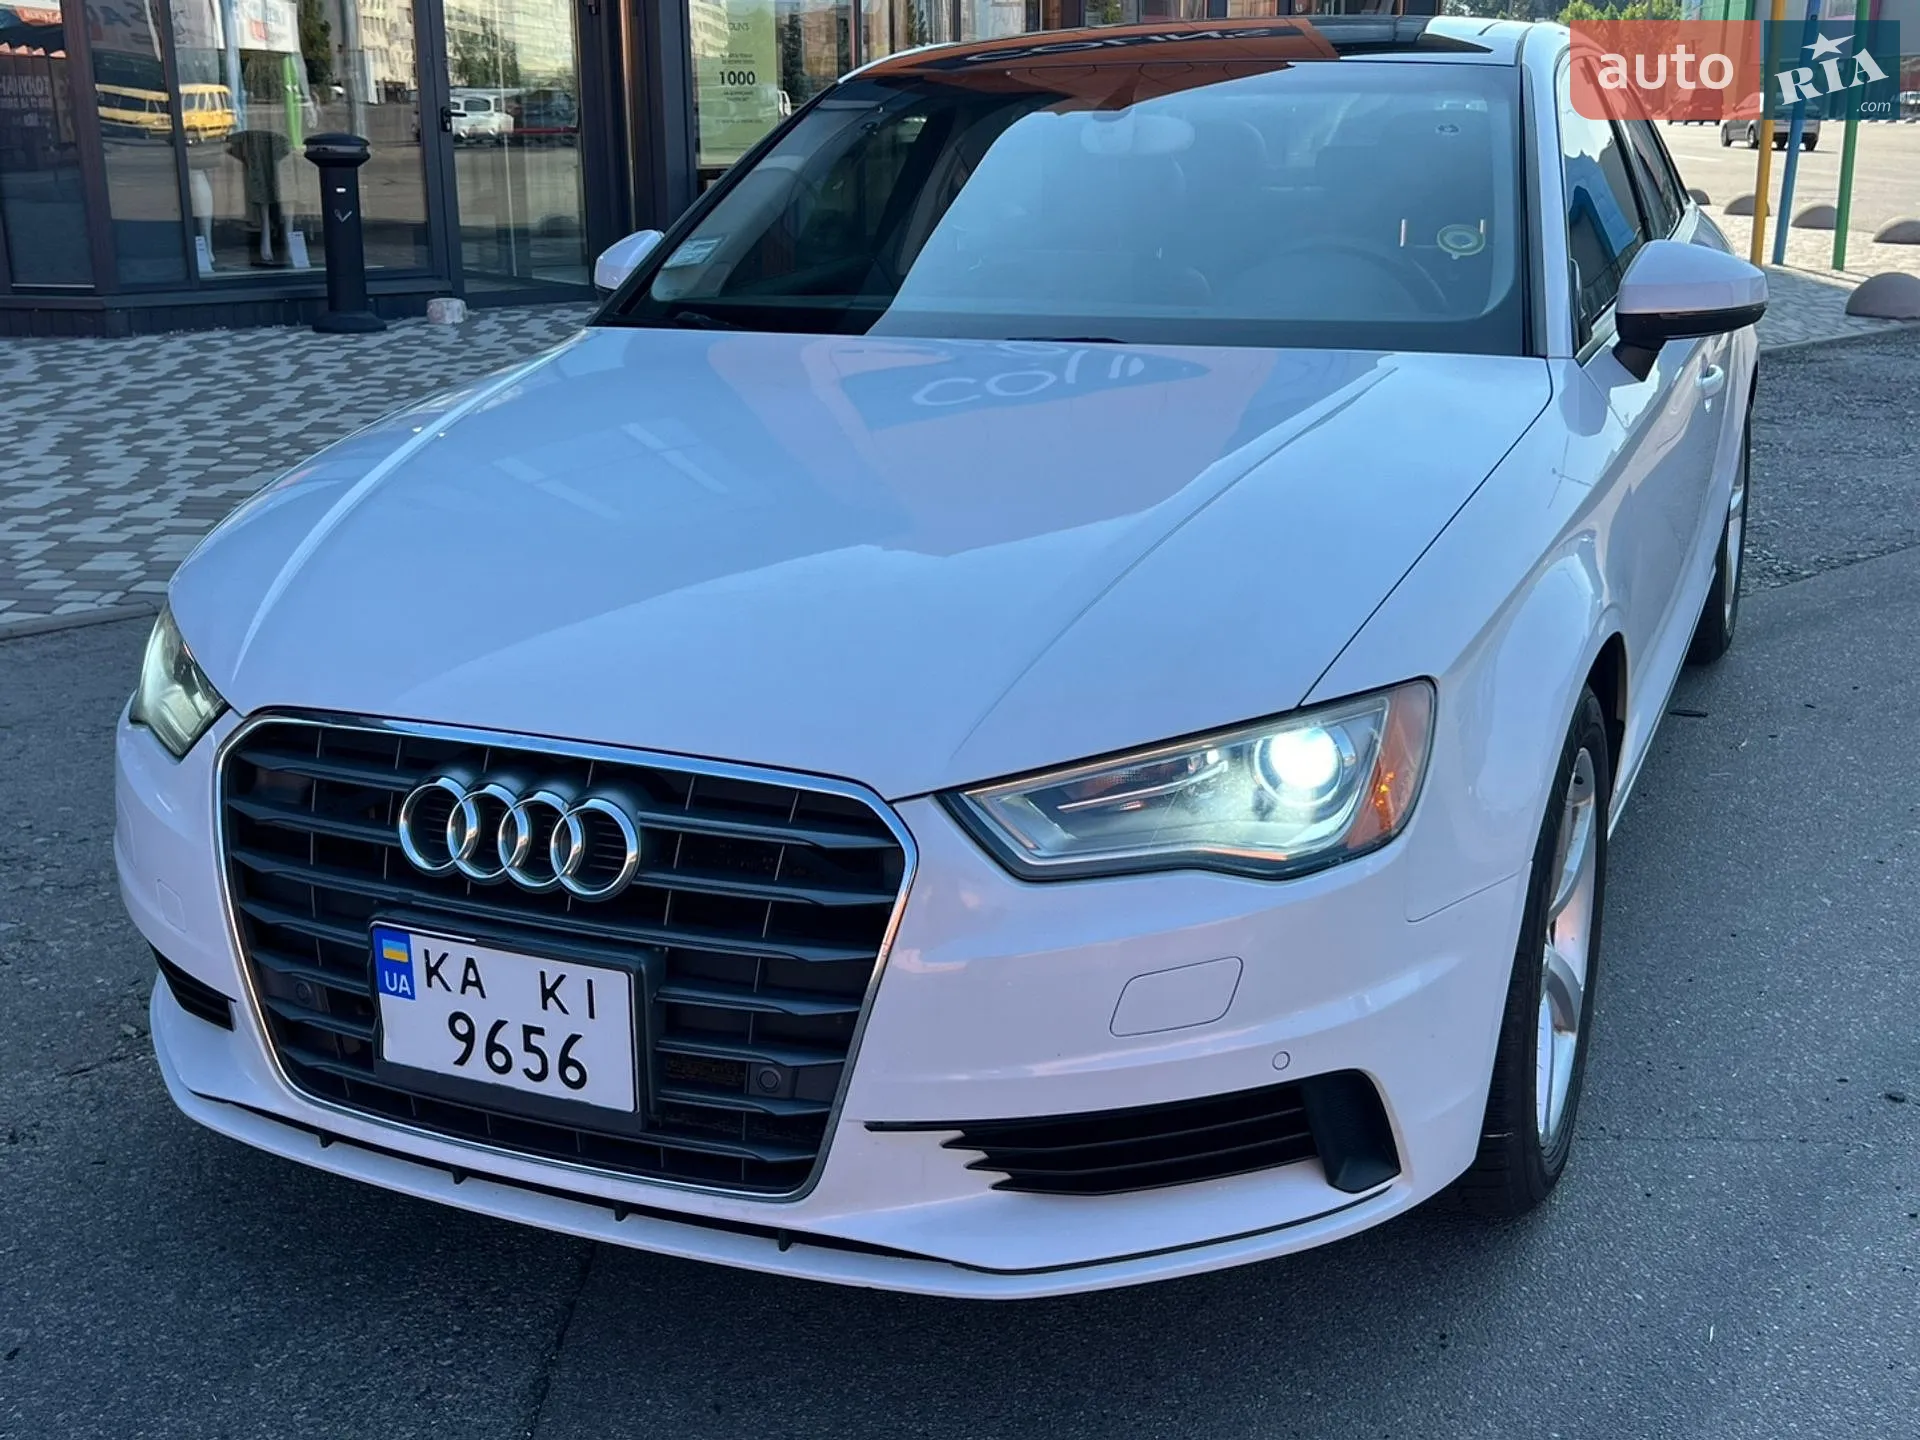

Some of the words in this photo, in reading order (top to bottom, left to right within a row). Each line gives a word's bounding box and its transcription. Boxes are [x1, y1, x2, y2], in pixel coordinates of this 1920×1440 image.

[719, 70, 756, 86] 1000
[384, 970, 412, 995] UA
[423, 948, 487, 1000] KA
[538, 970, 596, 1020] KI
[447, 1010, 588, 1091] 9656
